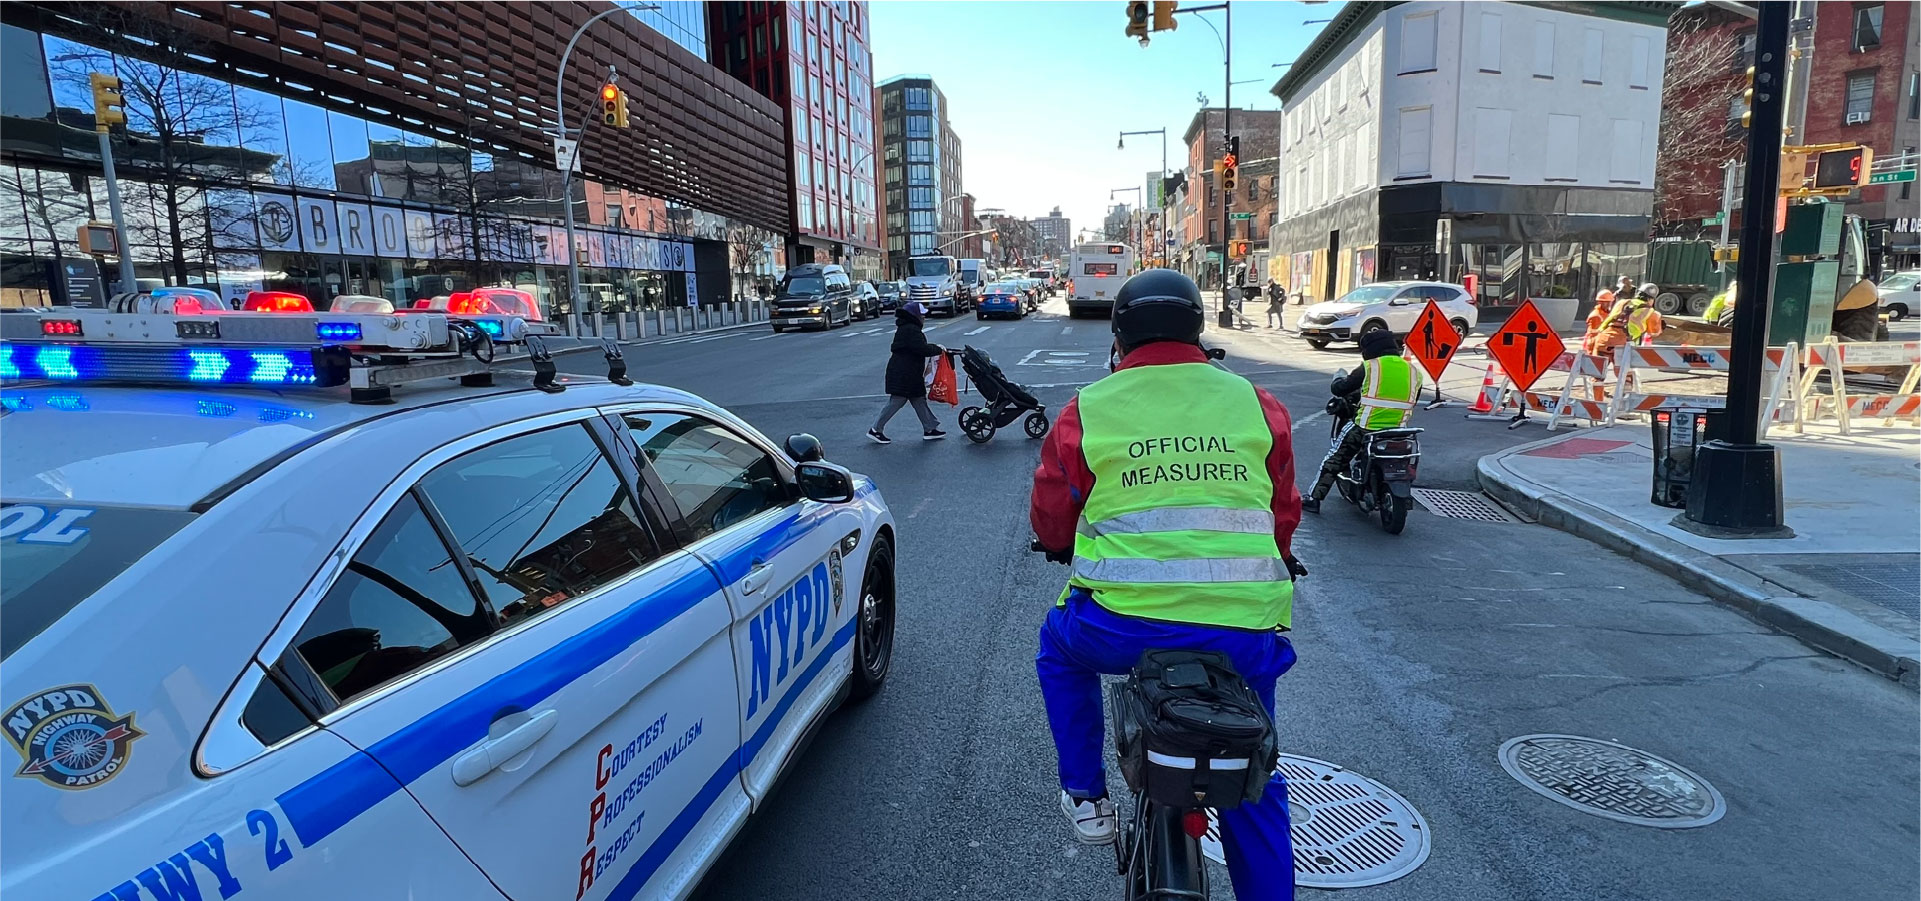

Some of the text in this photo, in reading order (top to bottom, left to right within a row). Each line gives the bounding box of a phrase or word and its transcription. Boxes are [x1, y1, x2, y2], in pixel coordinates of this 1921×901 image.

[1887, 173, 1898, 181] St
[1682, 352, 1715, 364] MECC
[1537, 398, 1557, 410] MEC
[1128, 436, 1235, 459] OFFICIAL
[1121, 463, 1248, 488] MEASURER
[746, 561, 830, 722] NYPD
[8, 689, 96, 739] NYPD
[32, 713, 97, 746] HIGHWAY
[595, 713, 667, 791] COURTESY
[65, 755, 123, 786] PATROL
[587, 718, 703, 847] PROFESSIONALISM
[245, 809, 293, 872] 2
[575, 810, 645, 900] RESPECT
